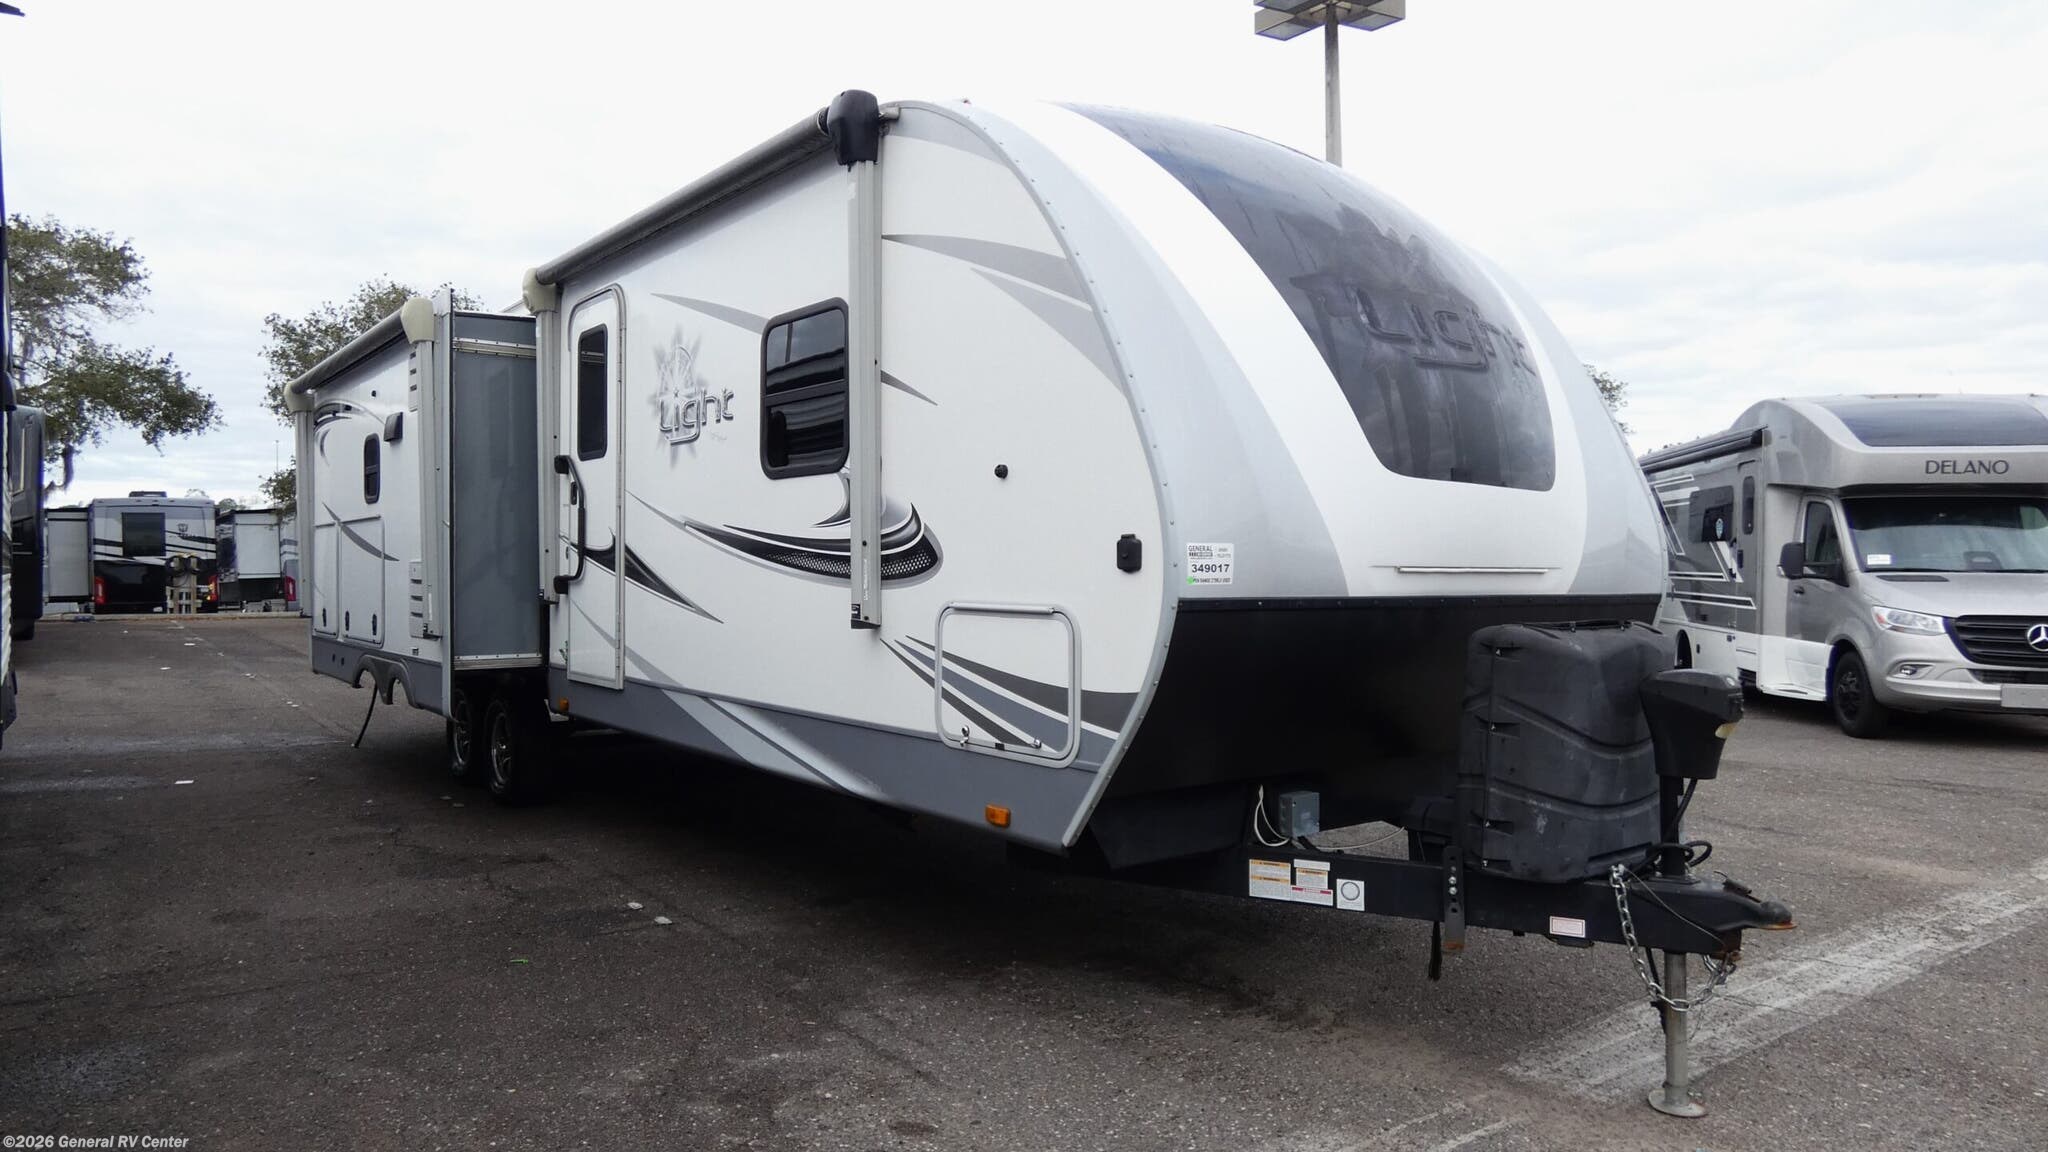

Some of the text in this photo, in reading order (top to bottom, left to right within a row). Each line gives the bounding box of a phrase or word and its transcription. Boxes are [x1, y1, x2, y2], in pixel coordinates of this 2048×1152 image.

[659, 386, 734, 447] Light
[1925, 460, 2010, 475] DELANO
[1191, 564, 1230, 573] 349017
